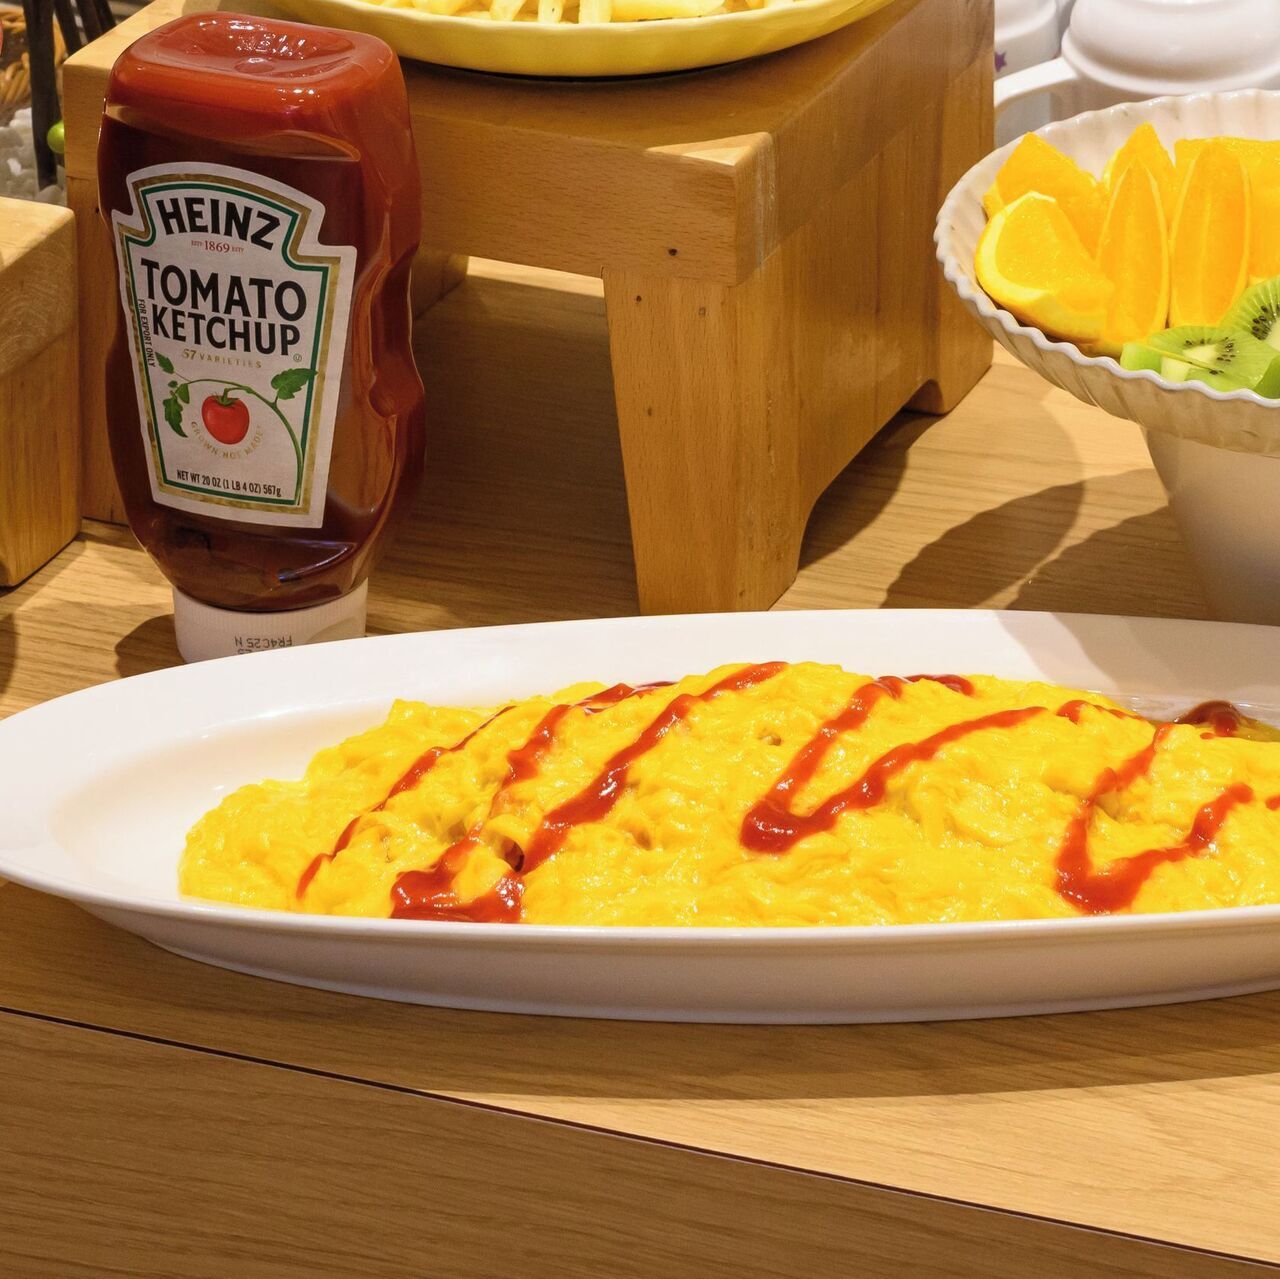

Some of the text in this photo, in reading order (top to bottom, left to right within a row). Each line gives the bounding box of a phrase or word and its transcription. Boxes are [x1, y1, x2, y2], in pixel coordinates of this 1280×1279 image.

[156, 197, 281, 251] HEINZ
[204, 240, 230, 254] 1869
[140, 257, 307, 322] TOMATO
[138, 299, 156, 368] FOR EXPORT ONLY
[152, 303, 300, 357] KETCHUP
[181, 348, 262, 369] 57 VARIETIES
[176, 469, 282, 498] NET WT 20 OZ (1 LB 4 OZ) 567g
